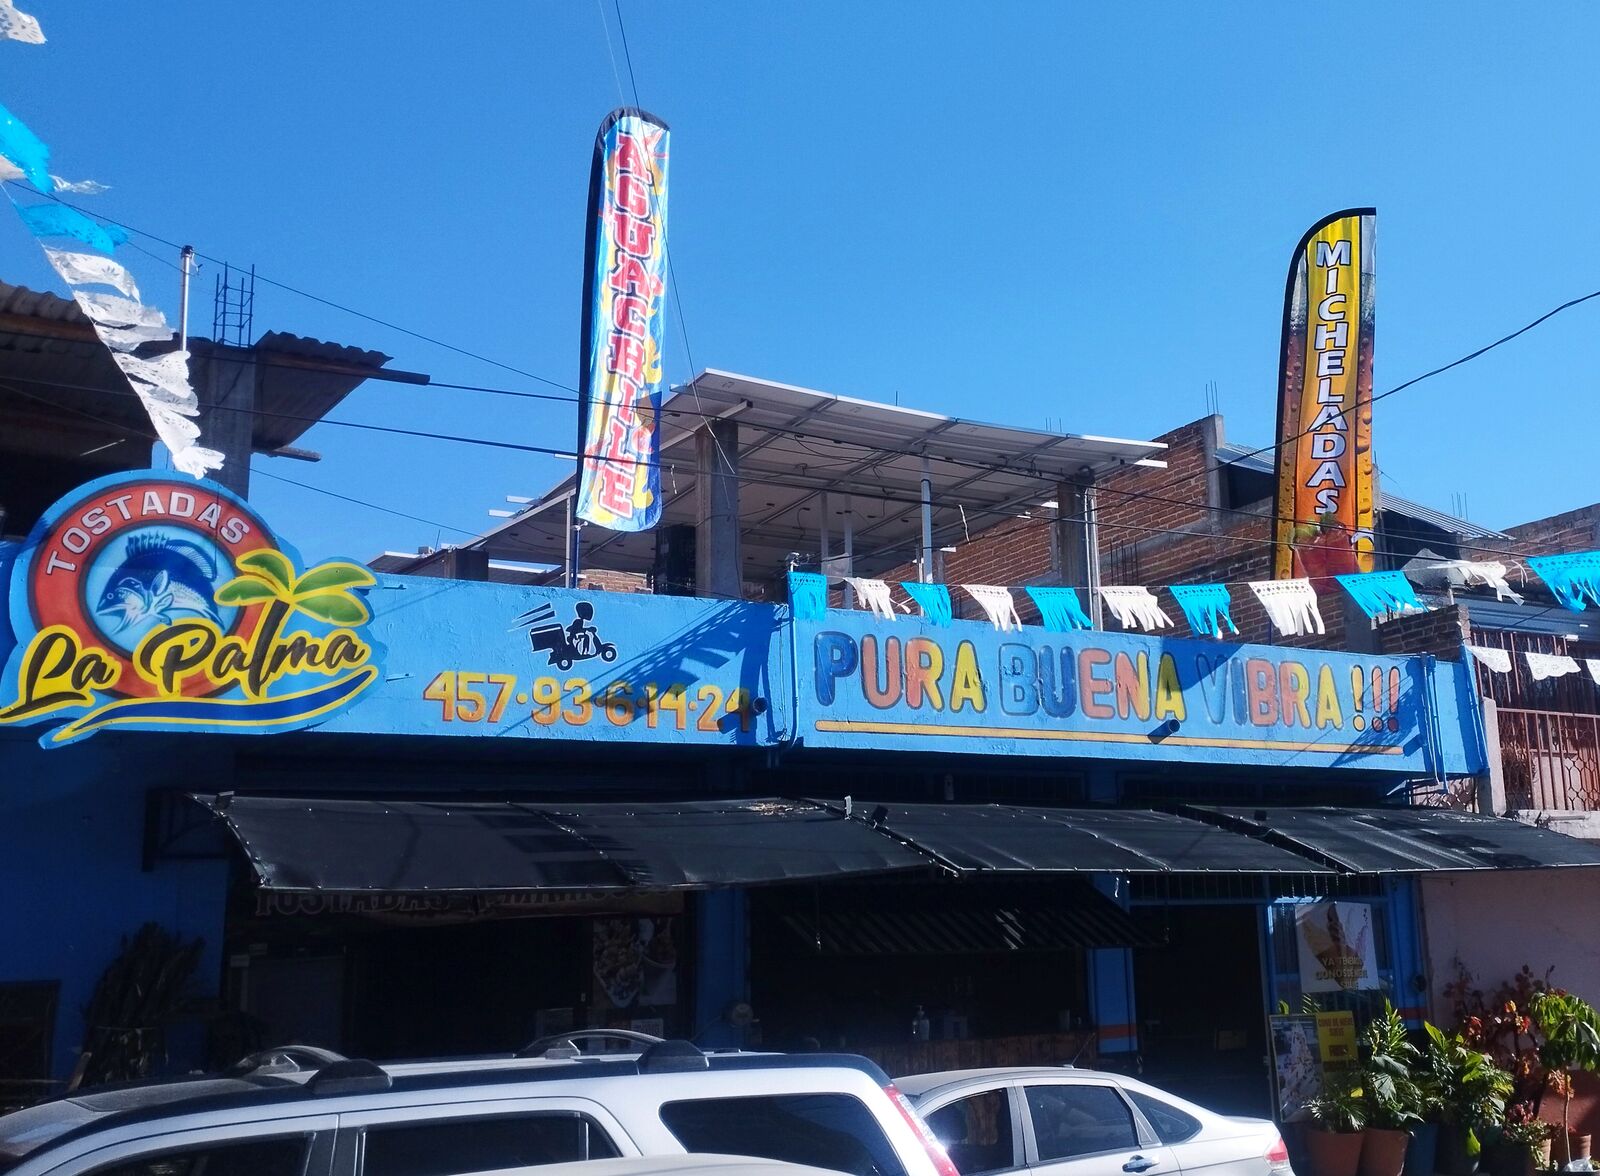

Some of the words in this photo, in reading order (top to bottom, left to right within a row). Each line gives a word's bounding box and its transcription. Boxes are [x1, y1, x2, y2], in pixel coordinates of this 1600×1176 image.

[600, 131, 654, 519] AGUACHILE
[1306, 240, 1352, 515] MICHELADAS
[46, 491, 249, 575] TOSTADAS
[0, 632, 116, 719] La
[140, 599, 366, 697] Palma
[814, 631, 987, 714] PURA
[999, 642, 1188, 722] BUENA
